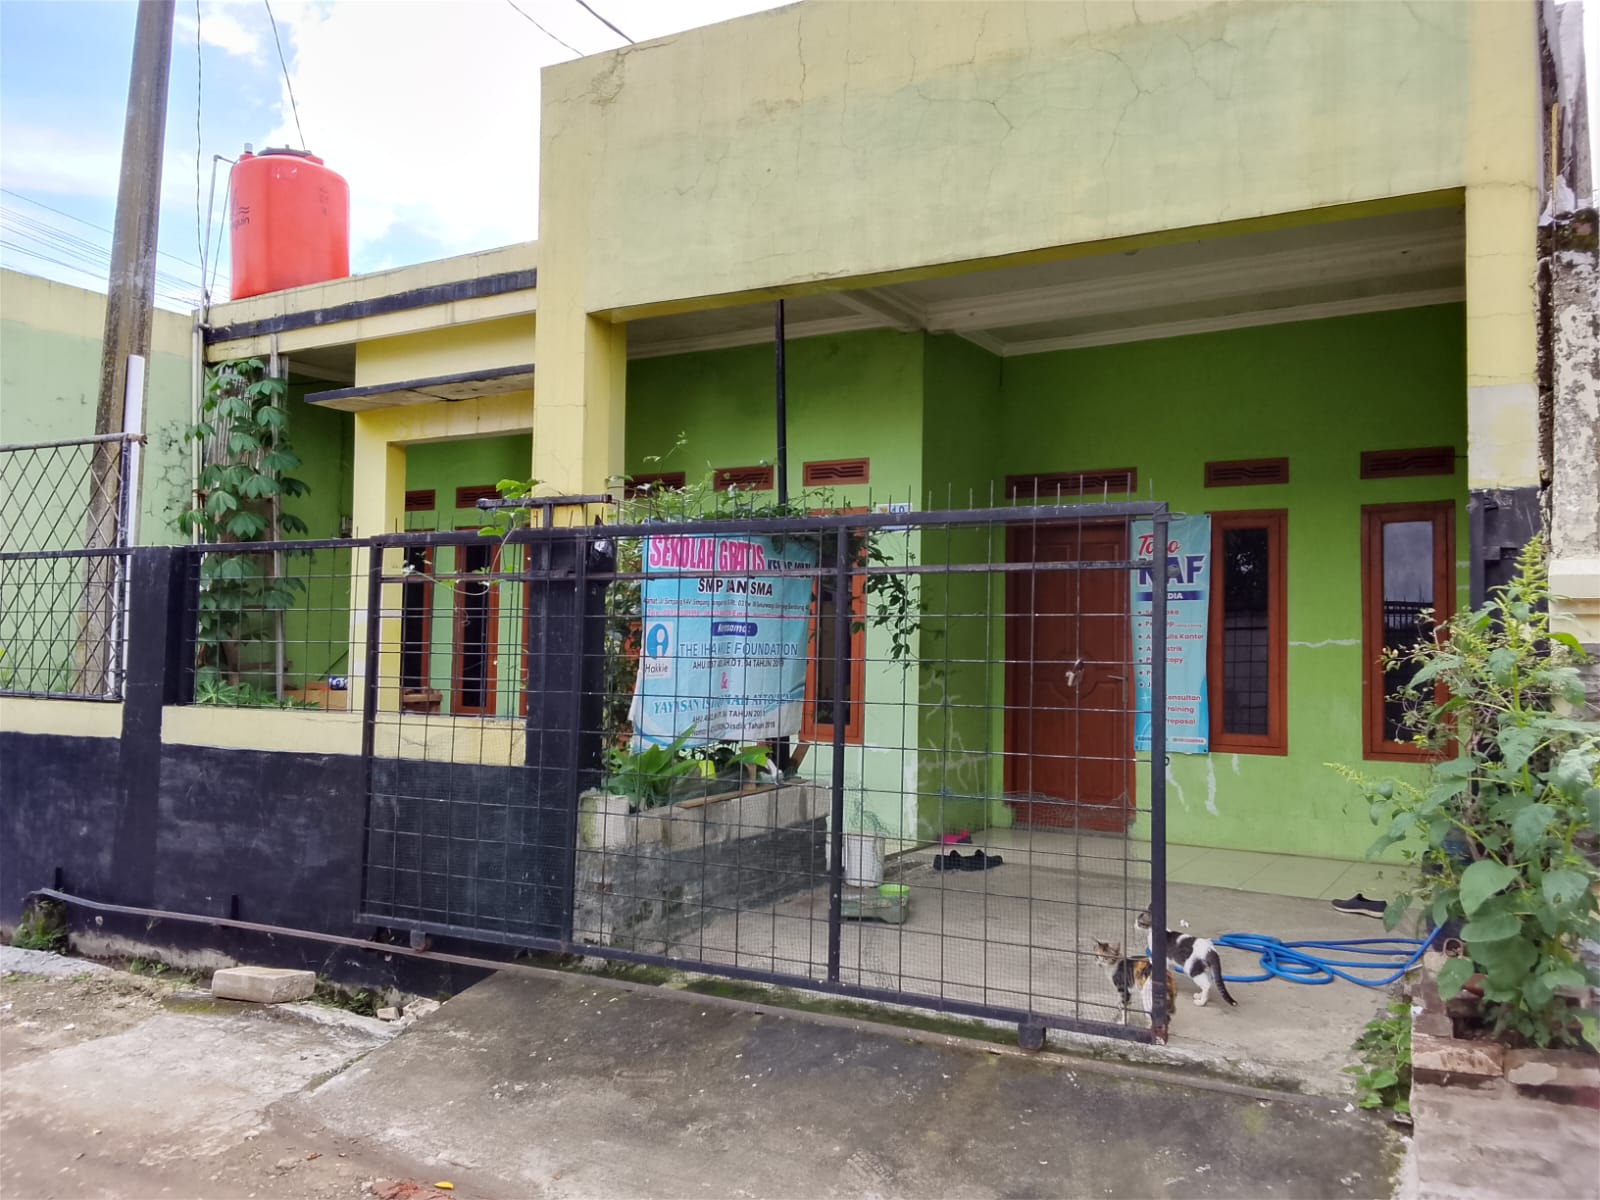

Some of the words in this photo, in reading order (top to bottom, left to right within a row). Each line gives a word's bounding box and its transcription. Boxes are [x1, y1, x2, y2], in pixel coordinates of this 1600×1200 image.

[650, 534, 714, 569] SEKOLAH
[718, 541, 765, 571] GRATIS
[1138, 534, 1180, 556] Too
[698, 578, 723, 593] SMP
[726, 580, 748, 594] AN
[750, 581, 773, 596] SMA
[680, 643, 698, 657] THE
[734, 641, 798, 656] FOUNDATION
[654, 699, 699, 714] YAYASAN
[728, 709, 752, 718] TAHUN
[1167, 706, 1195, 714] raining
[1167, 718, 1196, 726] roposal
